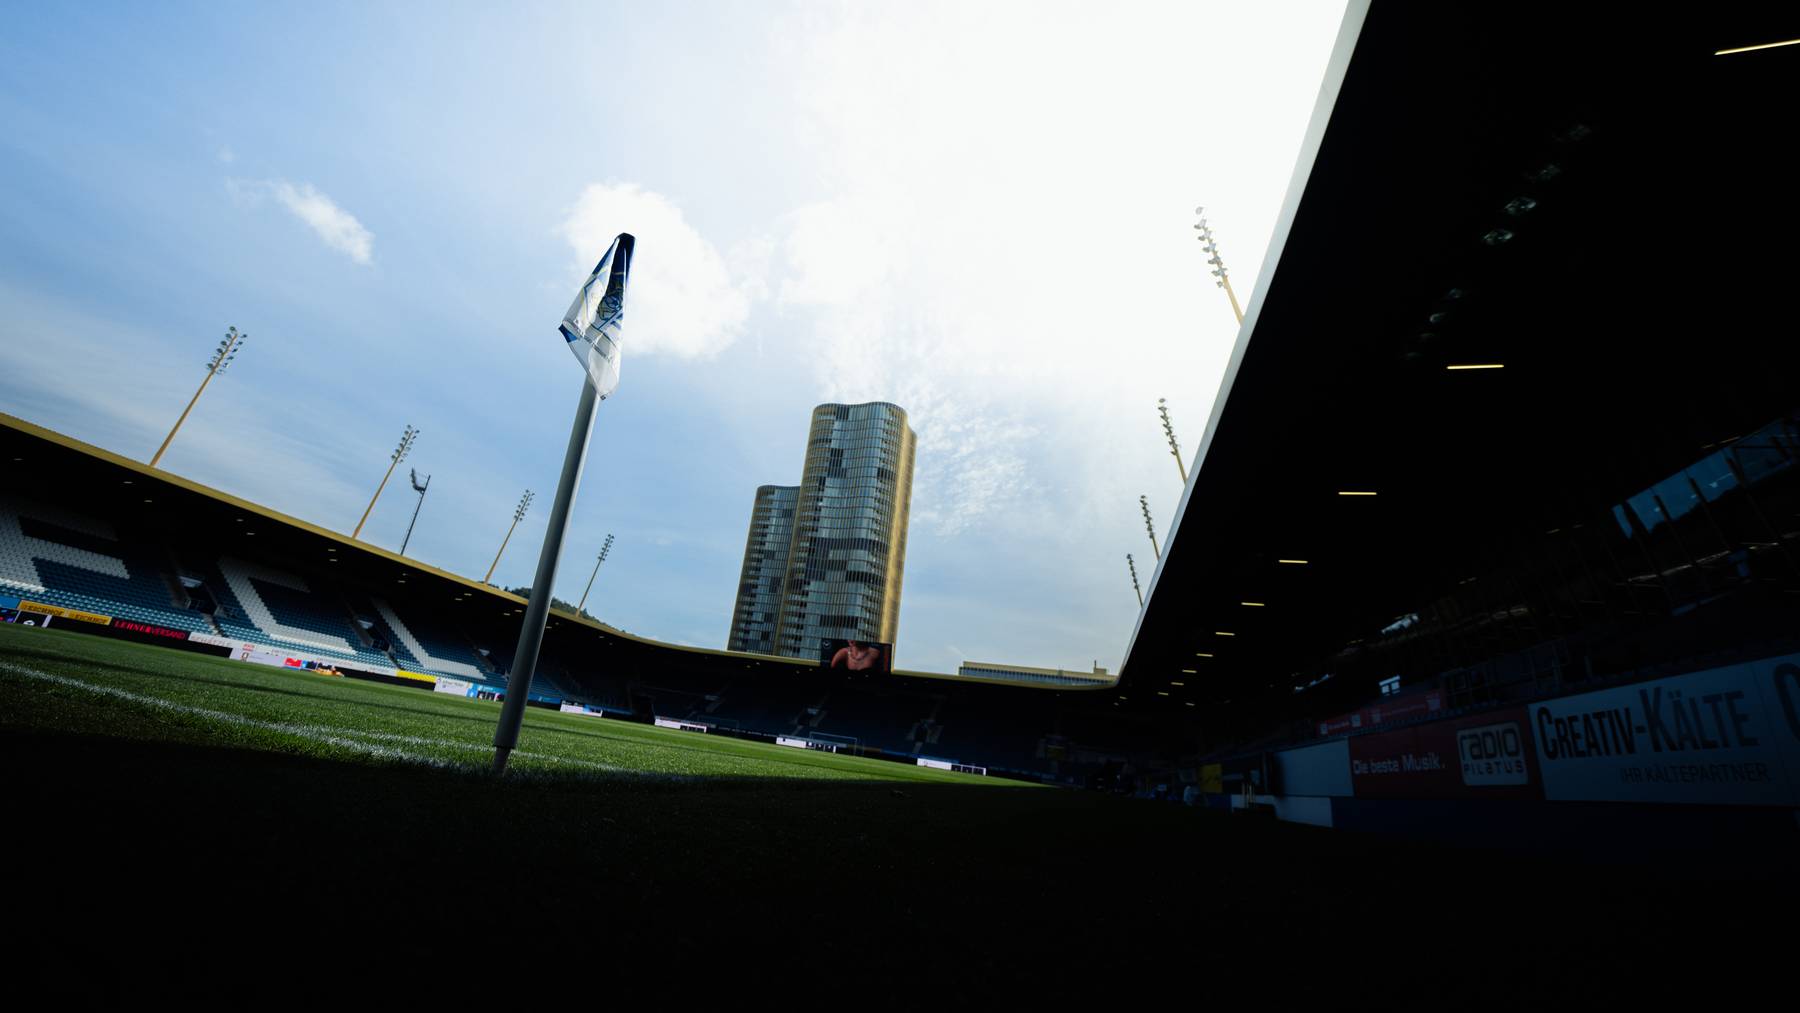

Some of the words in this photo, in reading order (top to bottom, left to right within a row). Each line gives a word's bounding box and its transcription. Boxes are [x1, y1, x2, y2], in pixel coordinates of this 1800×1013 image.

[1536, 686, 1760, 760] CREATIV-KÄLTE
[1353, 760, 1369, 775] Die
[1369, 758, 1400, 774] beste
[1402, 751, 1447, 772] Musik.
[1620, 766, 1642, 784] IHR
